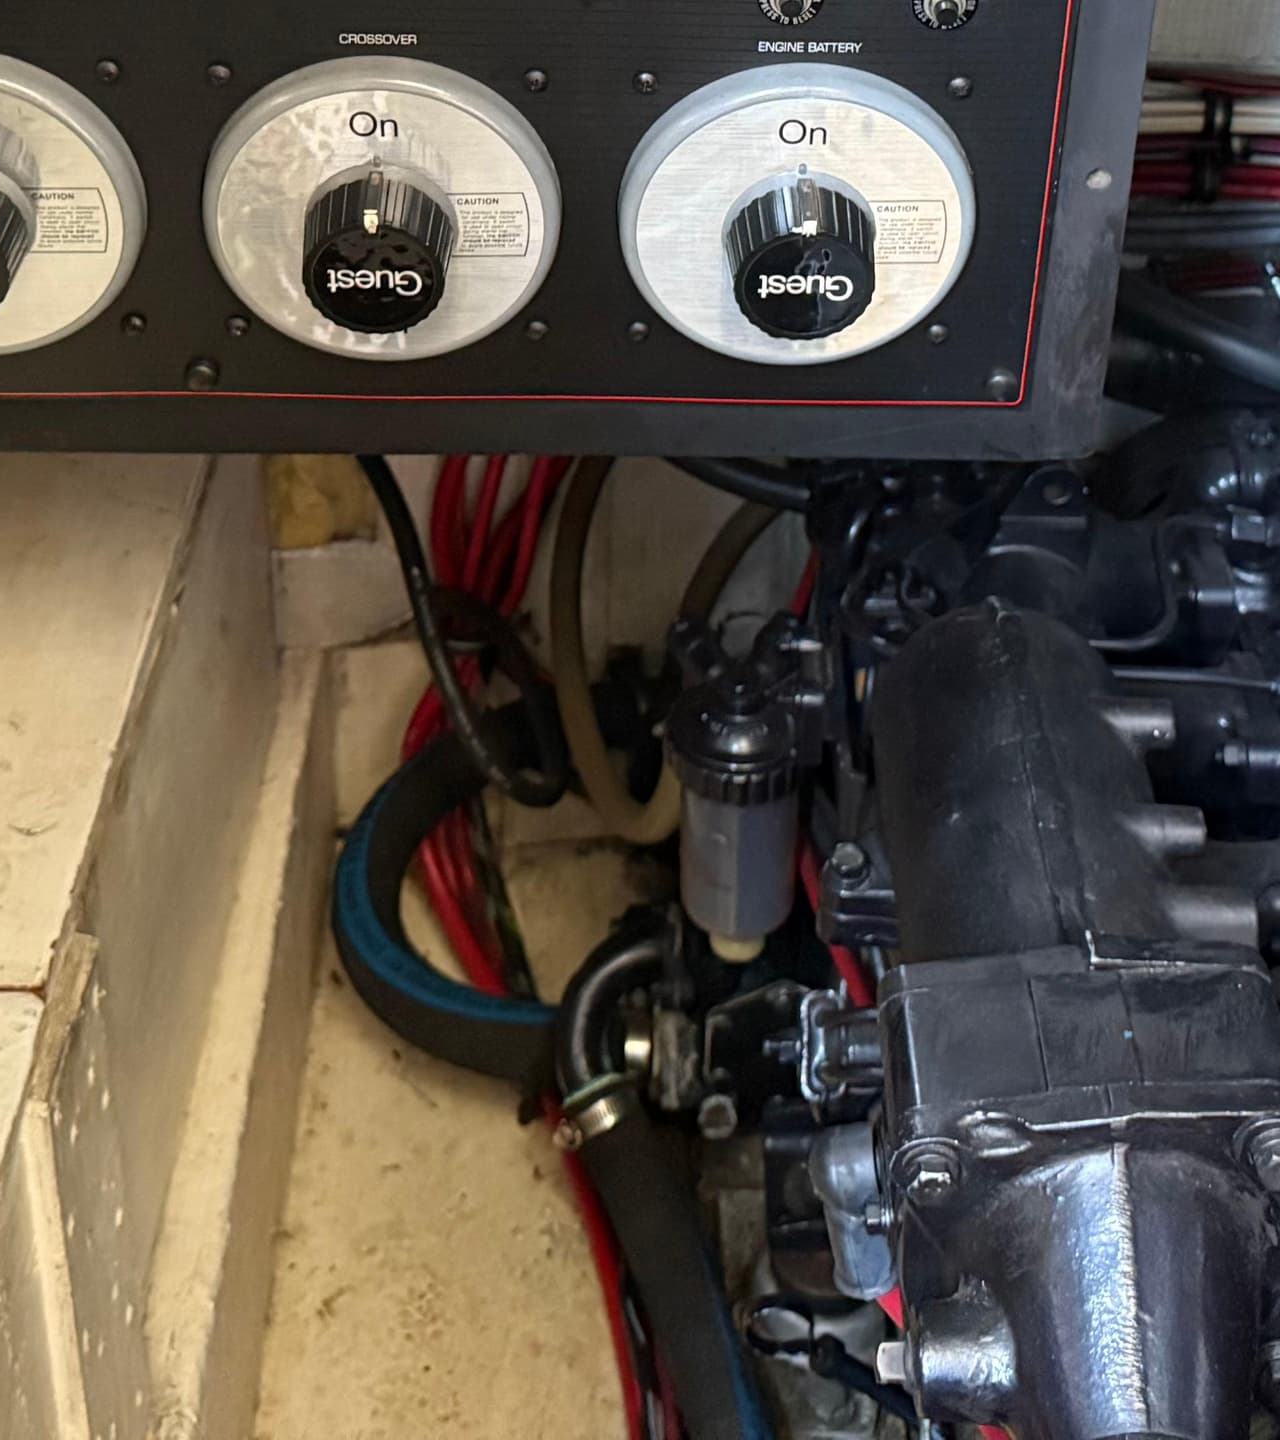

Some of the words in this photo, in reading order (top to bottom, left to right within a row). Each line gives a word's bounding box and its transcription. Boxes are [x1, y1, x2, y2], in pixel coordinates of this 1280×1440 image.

[339, 33, 417, 45] CROSSOVER
[758, 41, 805, 53] ENGINE
[808, 41, 862, 54] BATTERY
[348, 111, 399, 138] On
[778, 119, 828, 146] On
[31, 192, 74, 201] CAUTION
[456, 198, 500, 206] CAUTION
[877, 205, 919, 213] CAUTION
[326, 269, 423, 296] Guest
[757, 274, 854, 302] Guest
